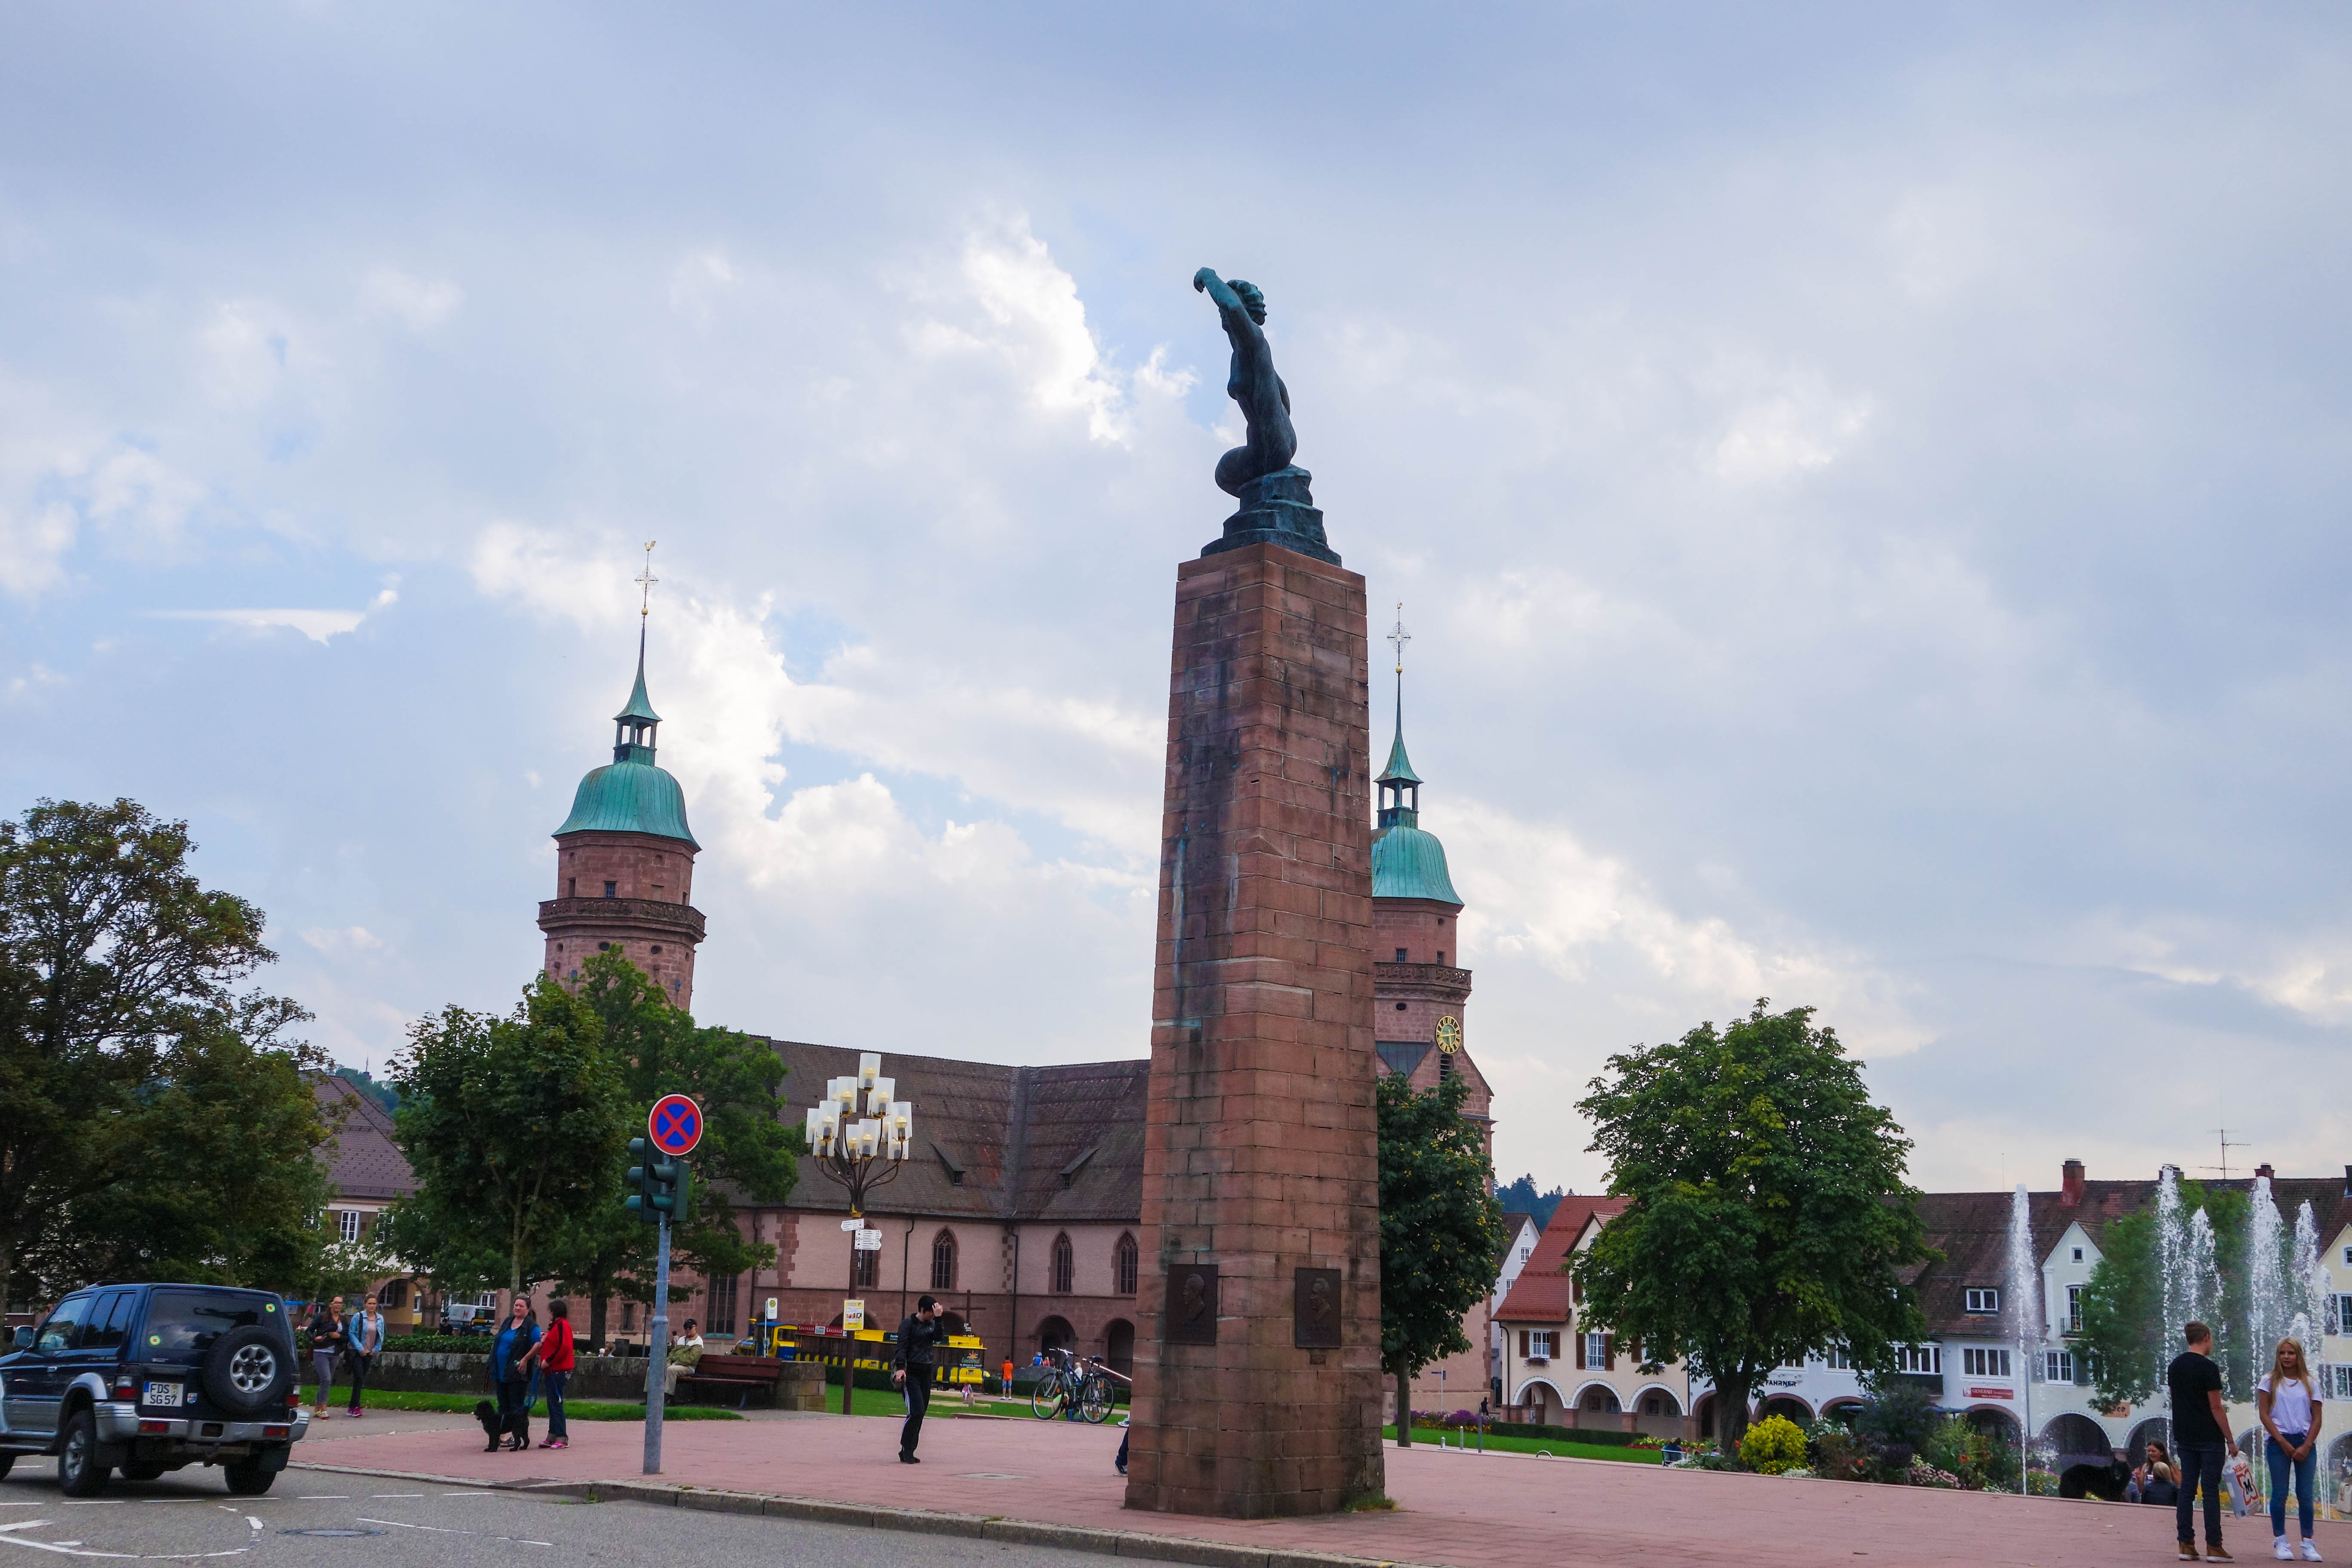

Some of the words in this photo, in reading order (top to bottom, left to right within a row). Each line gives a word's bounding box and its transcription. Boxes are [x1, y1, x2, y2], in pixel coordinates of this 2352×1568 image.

[150, 1384, 169, 1394] FDS
[150, 1394, 162, 1404] SG
[165, 1395, 177, 1405] 57
